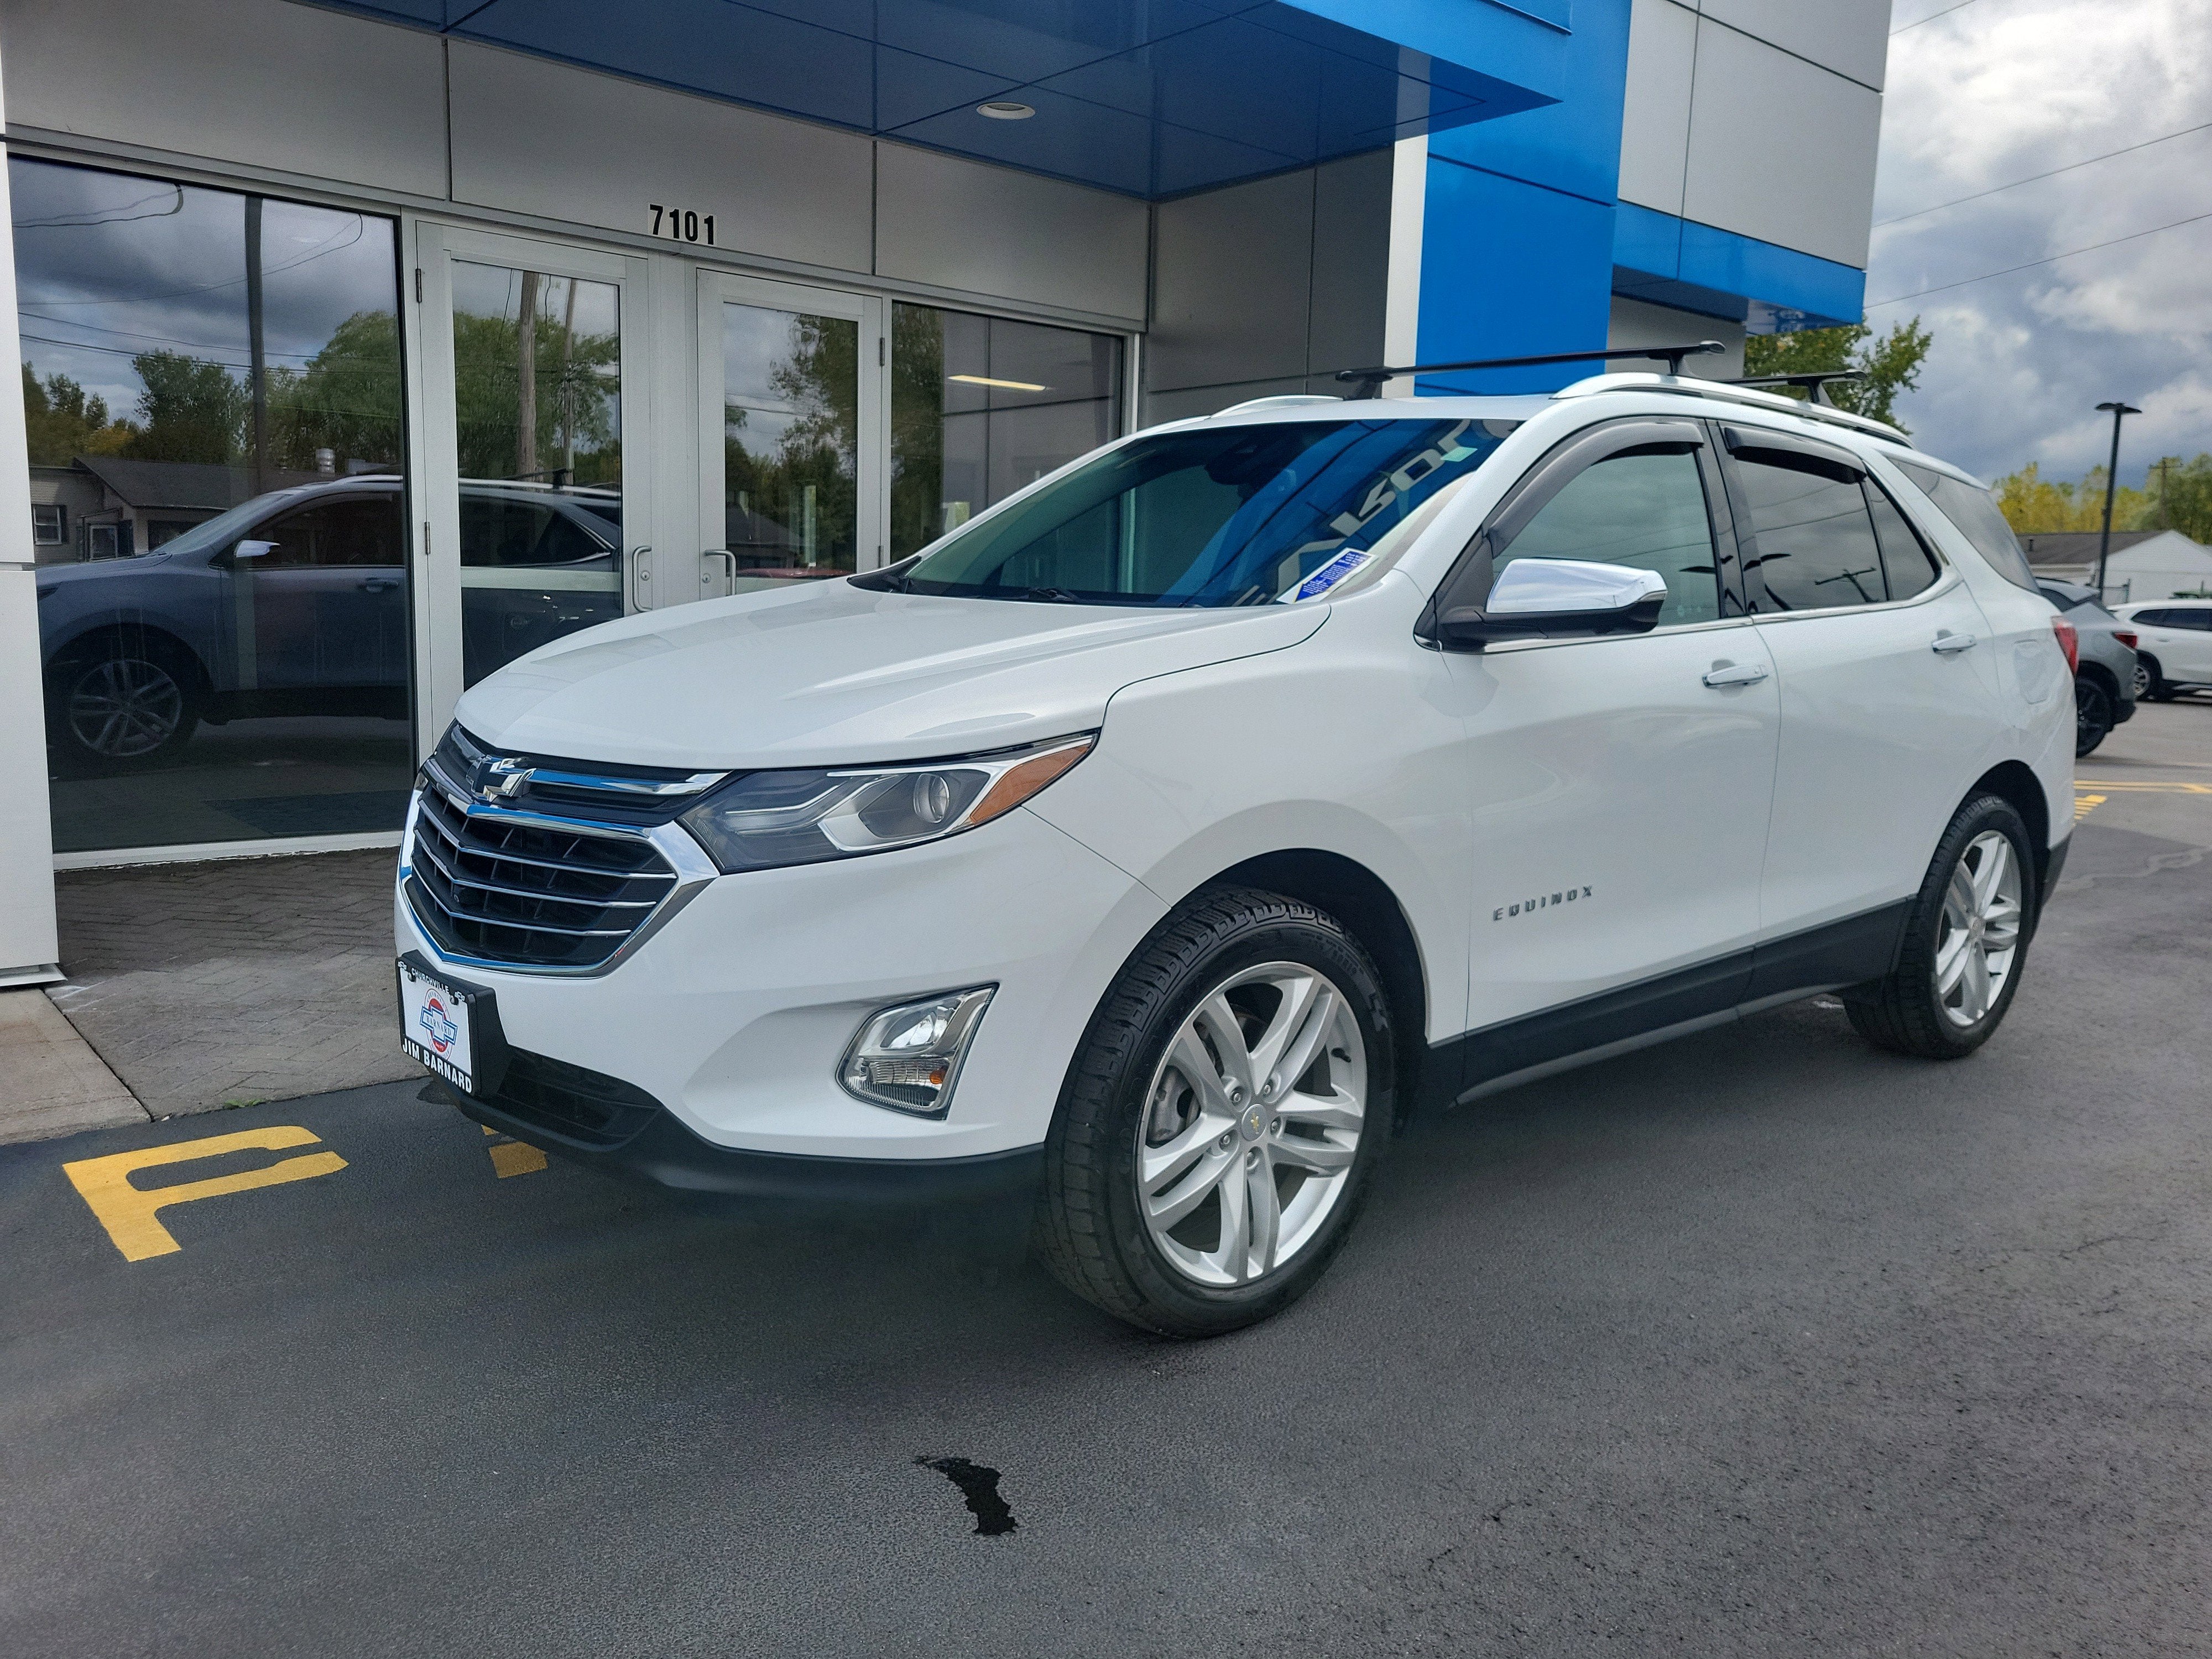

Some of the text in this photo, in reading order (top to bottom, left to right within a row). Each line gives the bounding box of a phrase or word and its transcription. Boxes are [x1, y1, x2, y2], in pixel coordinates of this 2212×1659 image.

[649, 204, 714, 246] 7101
[1493, 885, 1593, 921] EQUINOX
[411, 968, 450, 995] CHURCHVILLE
[426, 1014, 451, 1036] BARNARD
[402, 1038, 420, 1061] JIM
[423, 1051, 472, 1093] BARNARD
